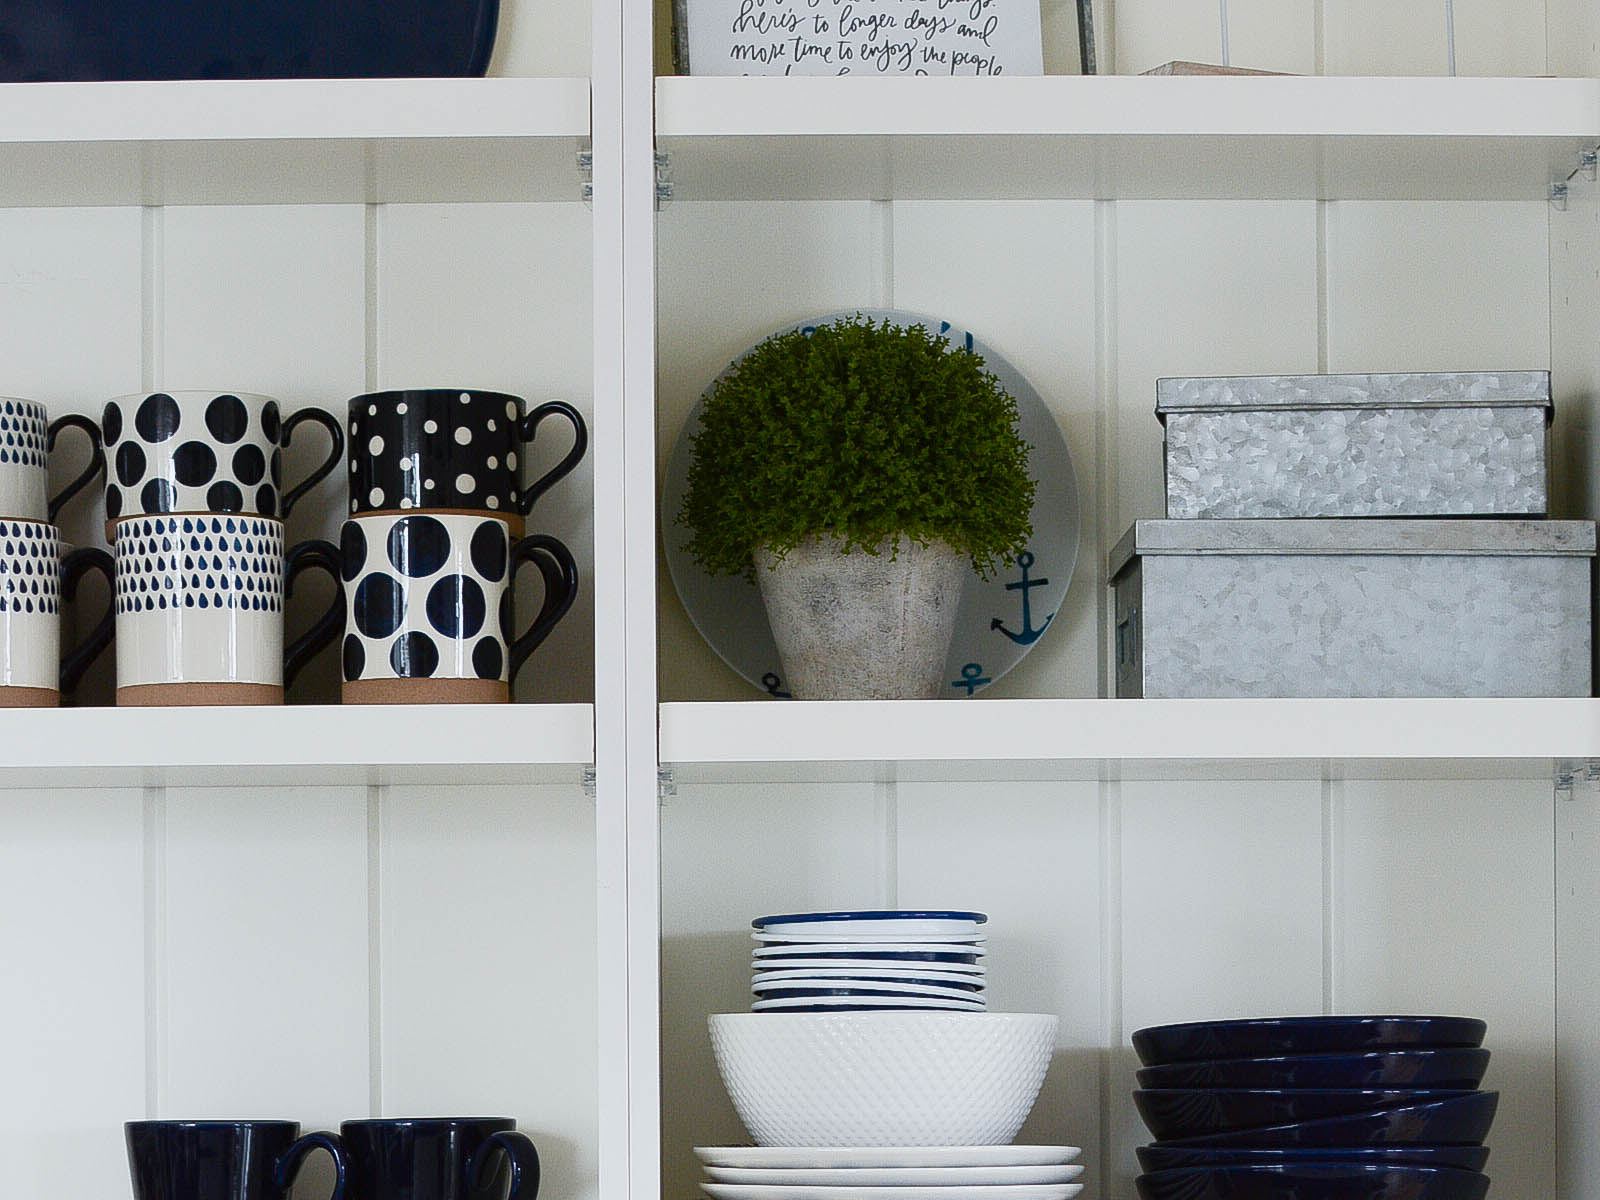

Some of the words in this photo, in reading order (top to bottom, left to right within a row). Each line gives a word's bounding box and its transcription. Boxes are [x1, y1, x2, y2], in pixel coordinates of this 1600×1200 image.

[812, 14, 829, 34] to
[839, 4, 897, 42] longer
[904, 9, 957, 40] days
[957, 16, 998, 47] and
[730, 43, 786, 65] more
[788, 35, 833, 64] time
[837, 41, 854, 61] to
[860, 35, 918, 73] enjoy
[919, 46, 946, 64] the
